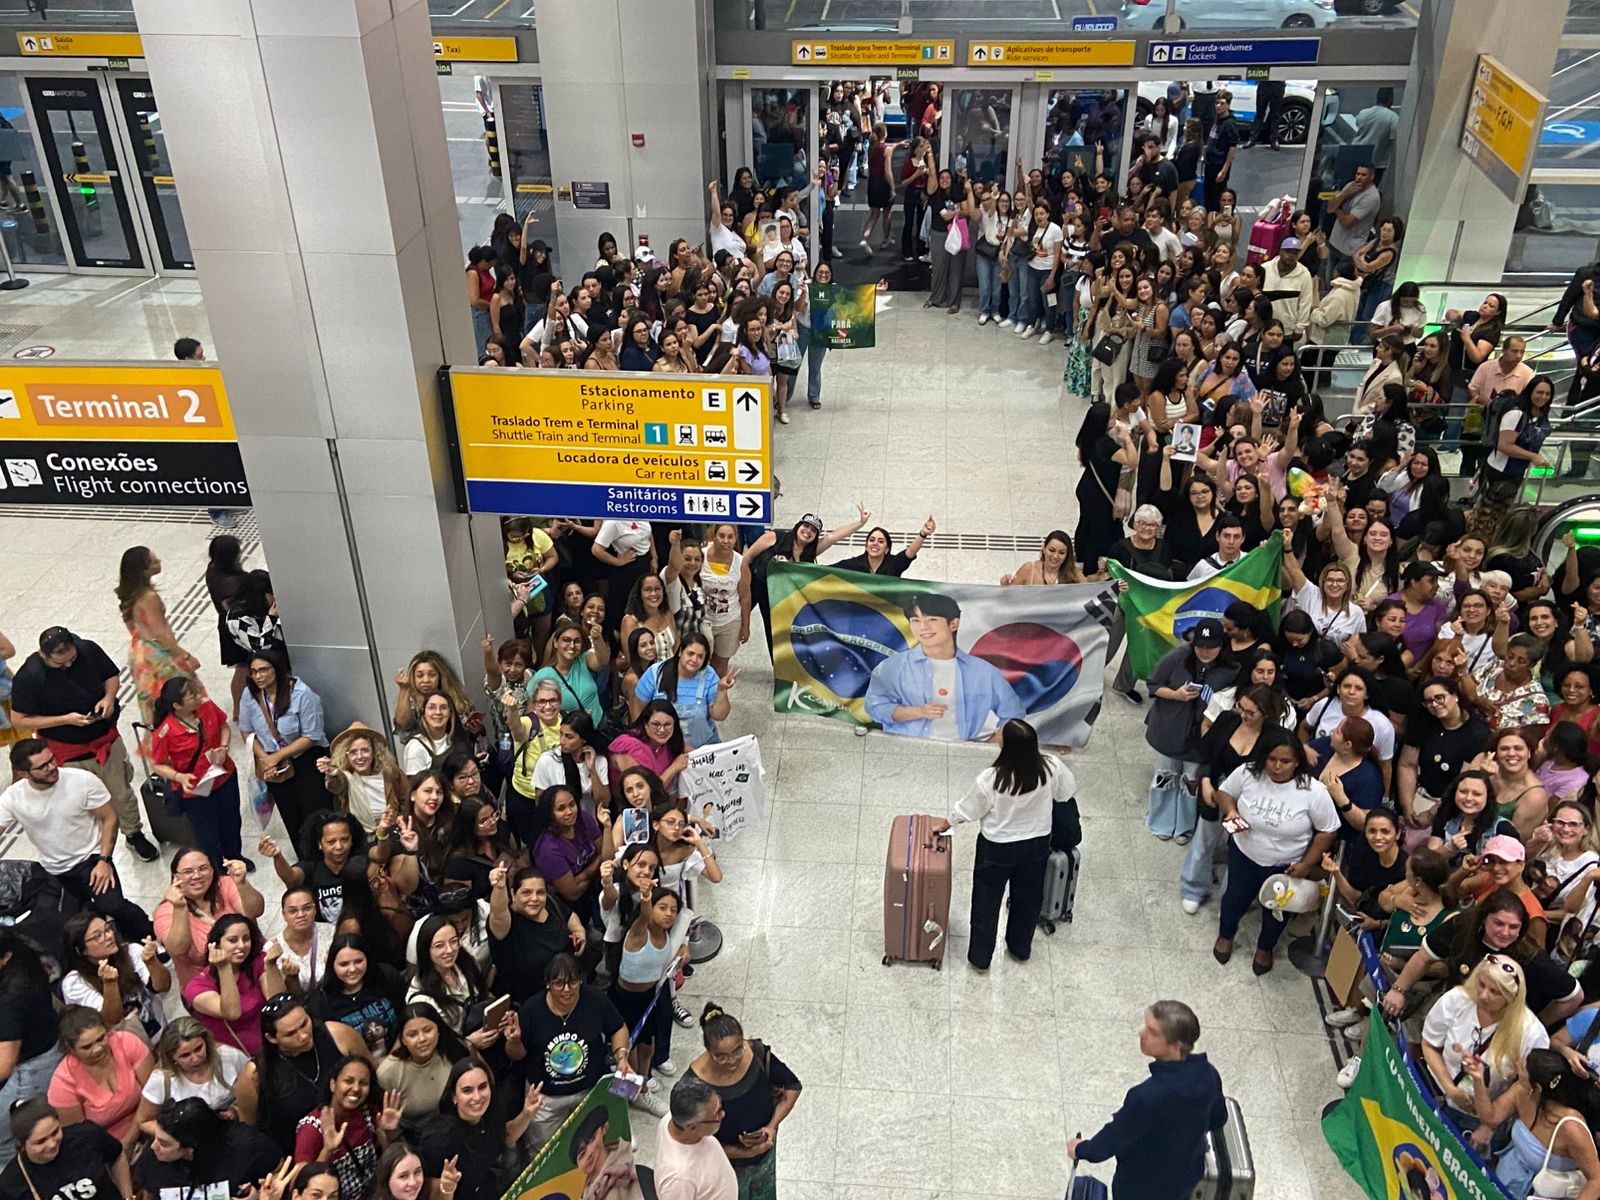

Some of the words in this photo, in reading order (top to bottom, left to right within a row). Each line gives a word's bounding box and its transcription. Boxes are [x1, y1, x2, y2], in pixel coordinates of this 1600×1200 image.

[926, 47, 931, 58] 1
[1007, 46, 1044, 54] Aplicativos
[1056, 46, 1091, 54] transporte
[1190, 44, 1253, 52] Guarda-volumes
[898, 69, 918, 77] SAÍDA
[1247, 69, 1268, 77] SAÍDA
[580, 384, 695, 400] Estacionamento
[708, 392, 720, 408] E
[37, 394, 169, 419] Terminal
[177, 389, 206, 423] 2
[581, 398, 634, 415] Parking
[491, 415, 541, 428] Traslado
[543, 417, 573, 429] Trem
[576, 421, 584, 430] e
[587, 418, 639, 431] Terminal
[491, 429, 534, 442] Shuttle
[536, 430, 564, 442] Train
[567, 432, 589, 443] and
[592, 432, 641, 445] Terminal
[652, 426, 661, 443] 1
[46, 452, 158, 472] Conexões
[557, 451, 619, 466] Locadora
[622, 455, 640, 467] de
[642, 454, 699, 468] veículos
[635, 467, 656, 480] Car
[660, 468, 700, 481] rental
[53, 475, 114, 498] Flight
[120, 477, 247, 494] connections
[608, 486, 677, 502] Sanitários
[606, 501, 678, 515] Restrooms
[547, 1032, 578, 1051] MUNDO
[1443, 1148, 1487, 1200] BRASI
